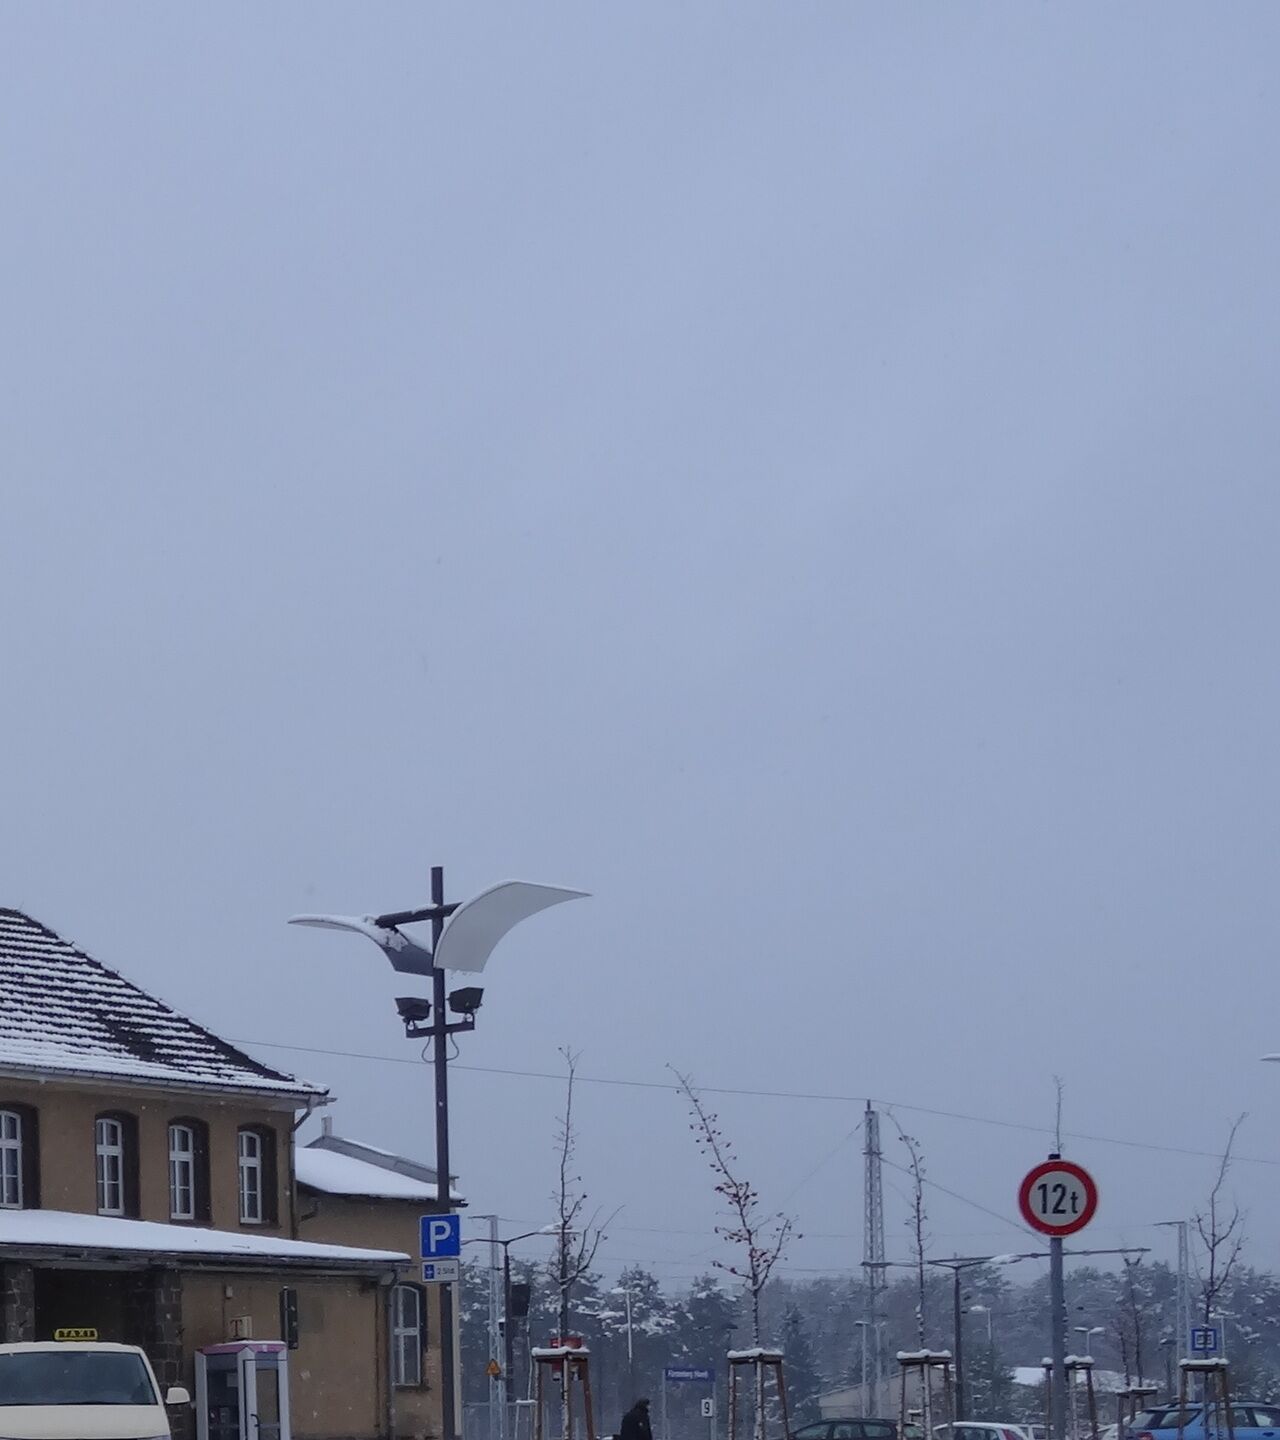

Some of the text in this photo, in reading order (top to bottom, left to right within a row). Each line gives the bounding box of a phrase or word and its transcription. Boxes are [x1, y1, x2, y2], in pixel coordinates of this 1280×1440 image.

[430, 1221, 451, 1253] P
[63, 1330, 91, 1338] TAXI
[704, 1401, 710, 1414] 9
